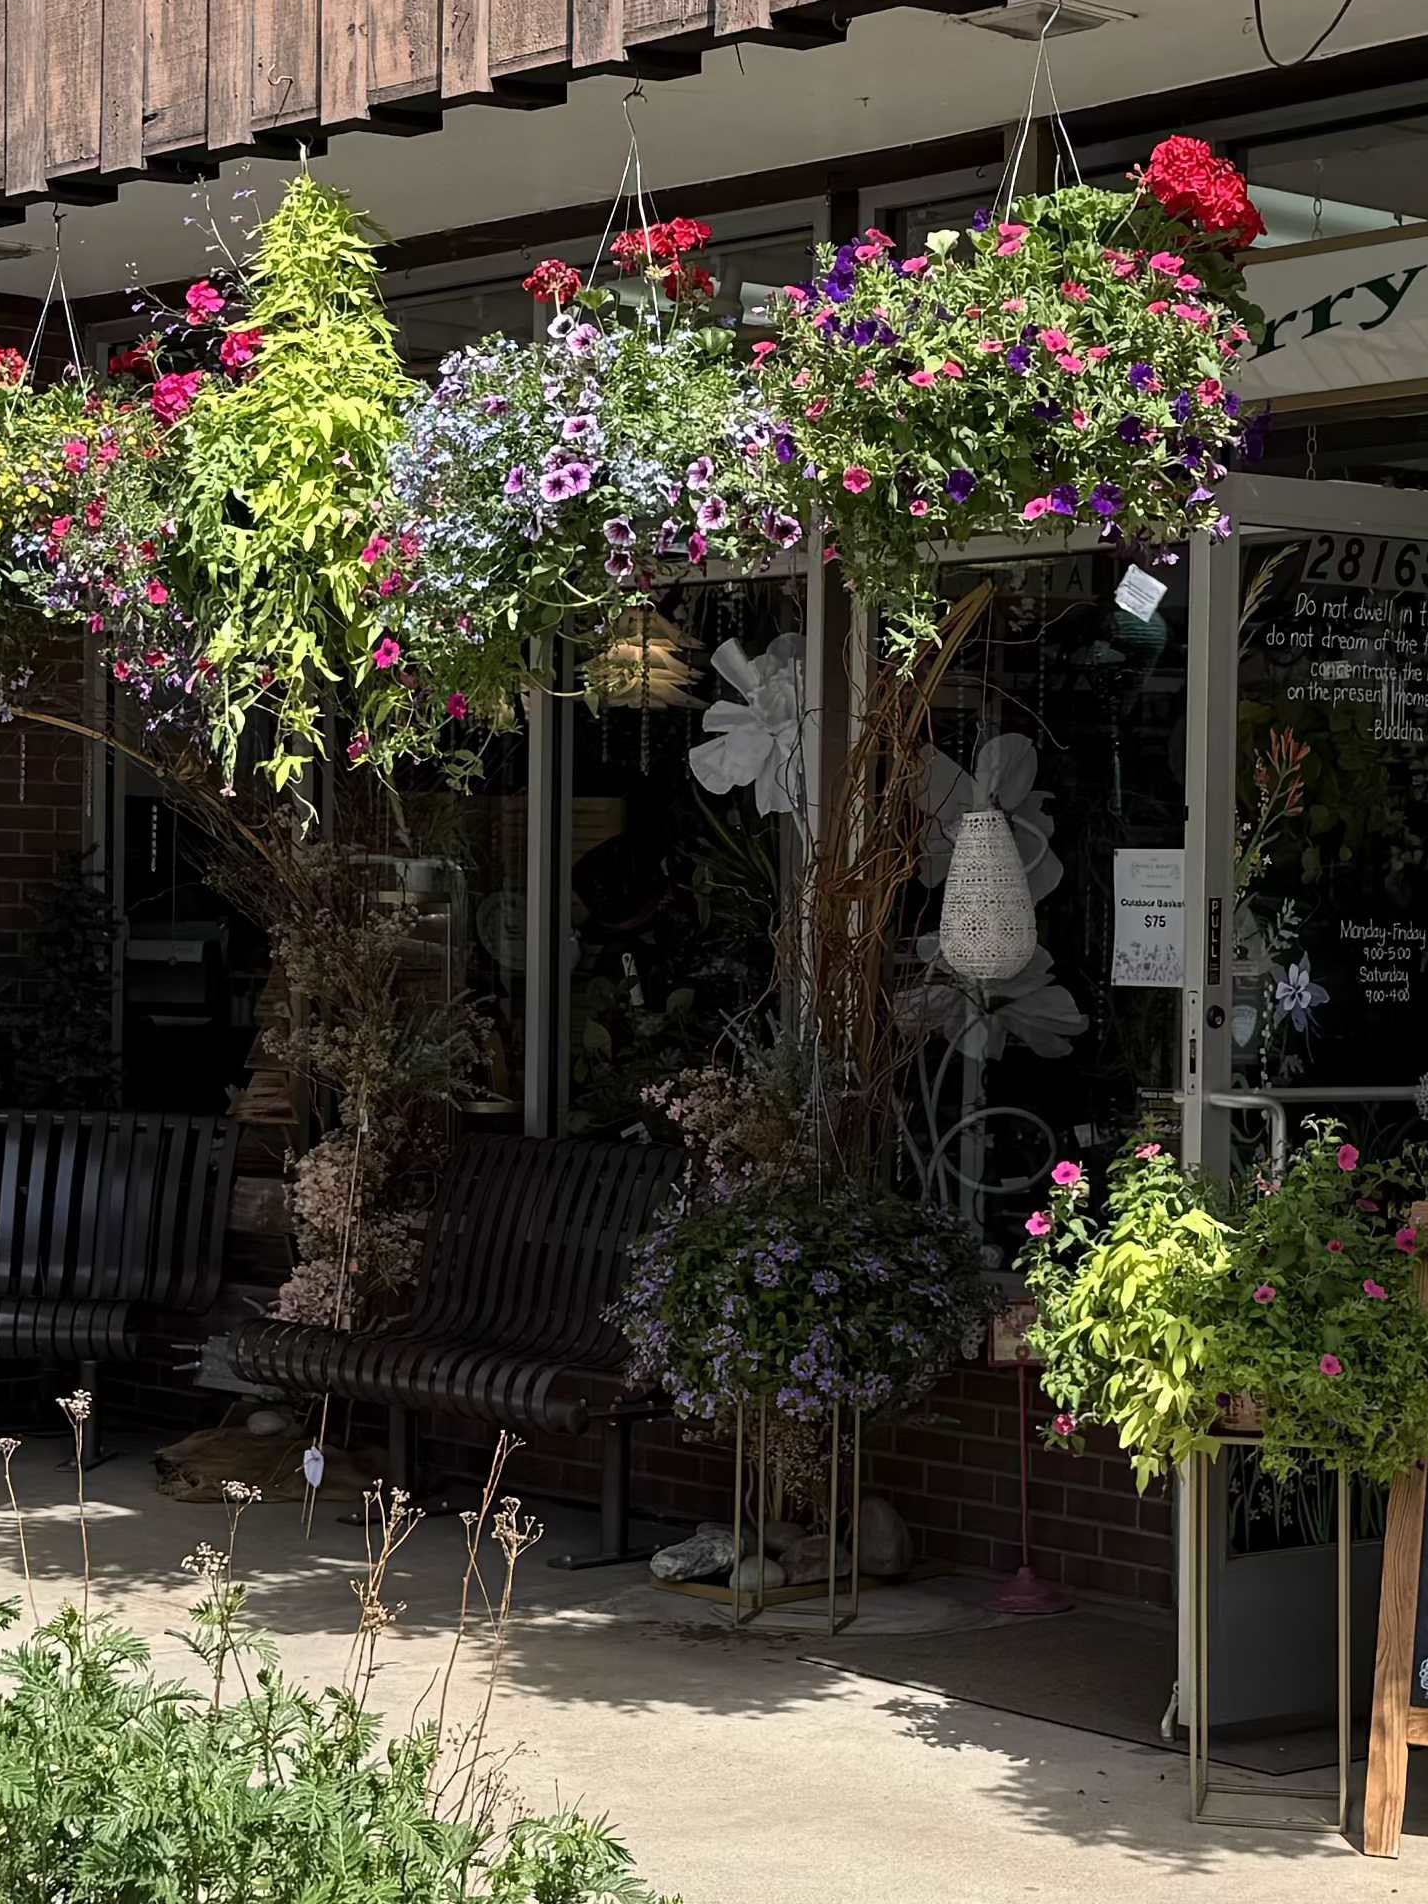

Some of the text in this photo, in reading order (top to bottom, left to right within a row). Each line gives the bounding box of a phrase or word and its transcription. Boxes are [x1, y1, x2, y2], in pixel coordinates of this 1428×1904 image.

[1294, 592, 1317, 617] Do
[1322, 596, 1349, 620] not
[1353, 597, 1394, 622] dwell
[1399, 604, 1413, 624] in
[1266, 623, 1285, 646] do
[1290, 628, 1314, 648] not
[1322, 625, 1368, 650] dream
[1374, 628, 1390, 652] of
[1394, 630, 1418, 655] the
[1310, 660, 1397, 682] concentrate
[1402, 663, 1422, 681] the
[1287, 684, 1304, 700] on
[1308, 681, 1331, 701] the
[1144, 914, 1166, 929] $75
[1211, 900, 1220, 958] PULL
[1359, 964, 1410, 991] Saturday
